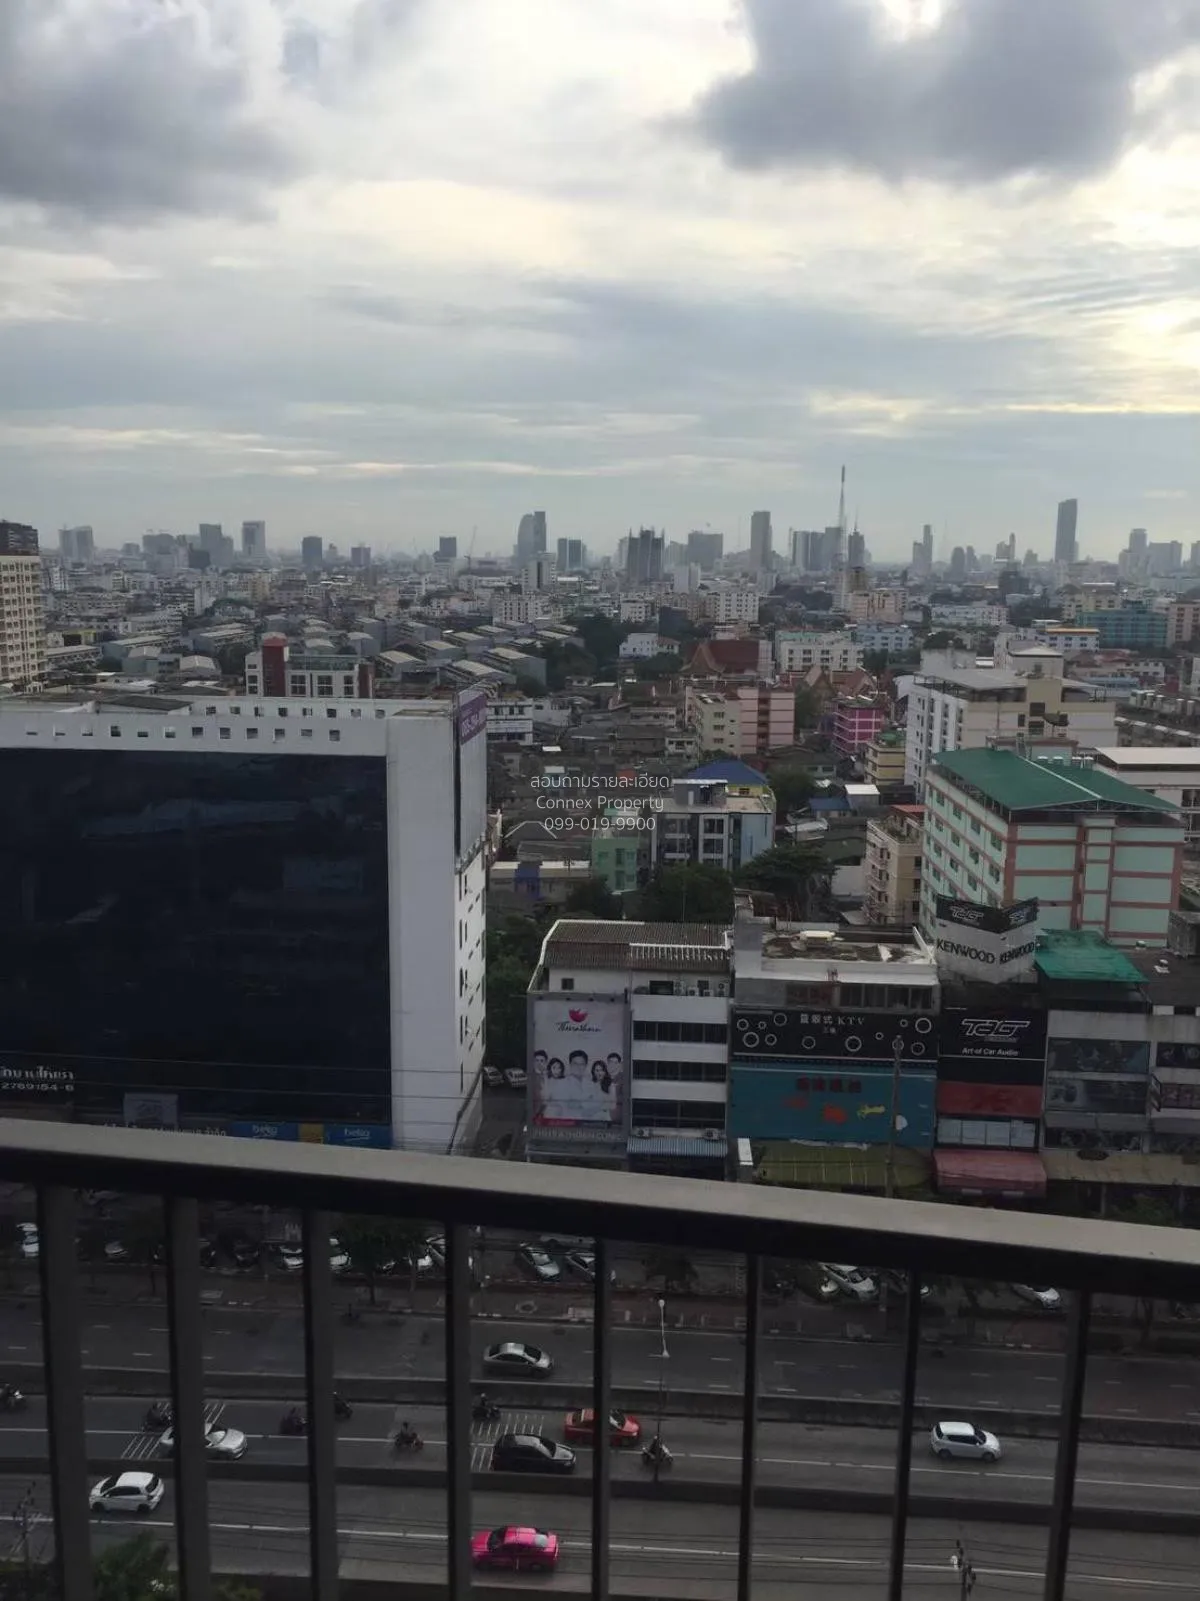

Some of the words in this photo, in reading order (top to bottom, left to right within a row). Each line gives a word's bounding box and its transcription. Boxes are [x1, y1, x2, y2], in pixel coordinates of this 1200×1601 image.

[936, 938, 996, 964] KENWOOD
[999, 941, 1035, 965] KENWOOD
[962, 1047, 973, 1055] Art
[983, 1047, 996, 1055] Car
[997, 1048, 1019, 1056] Audio
